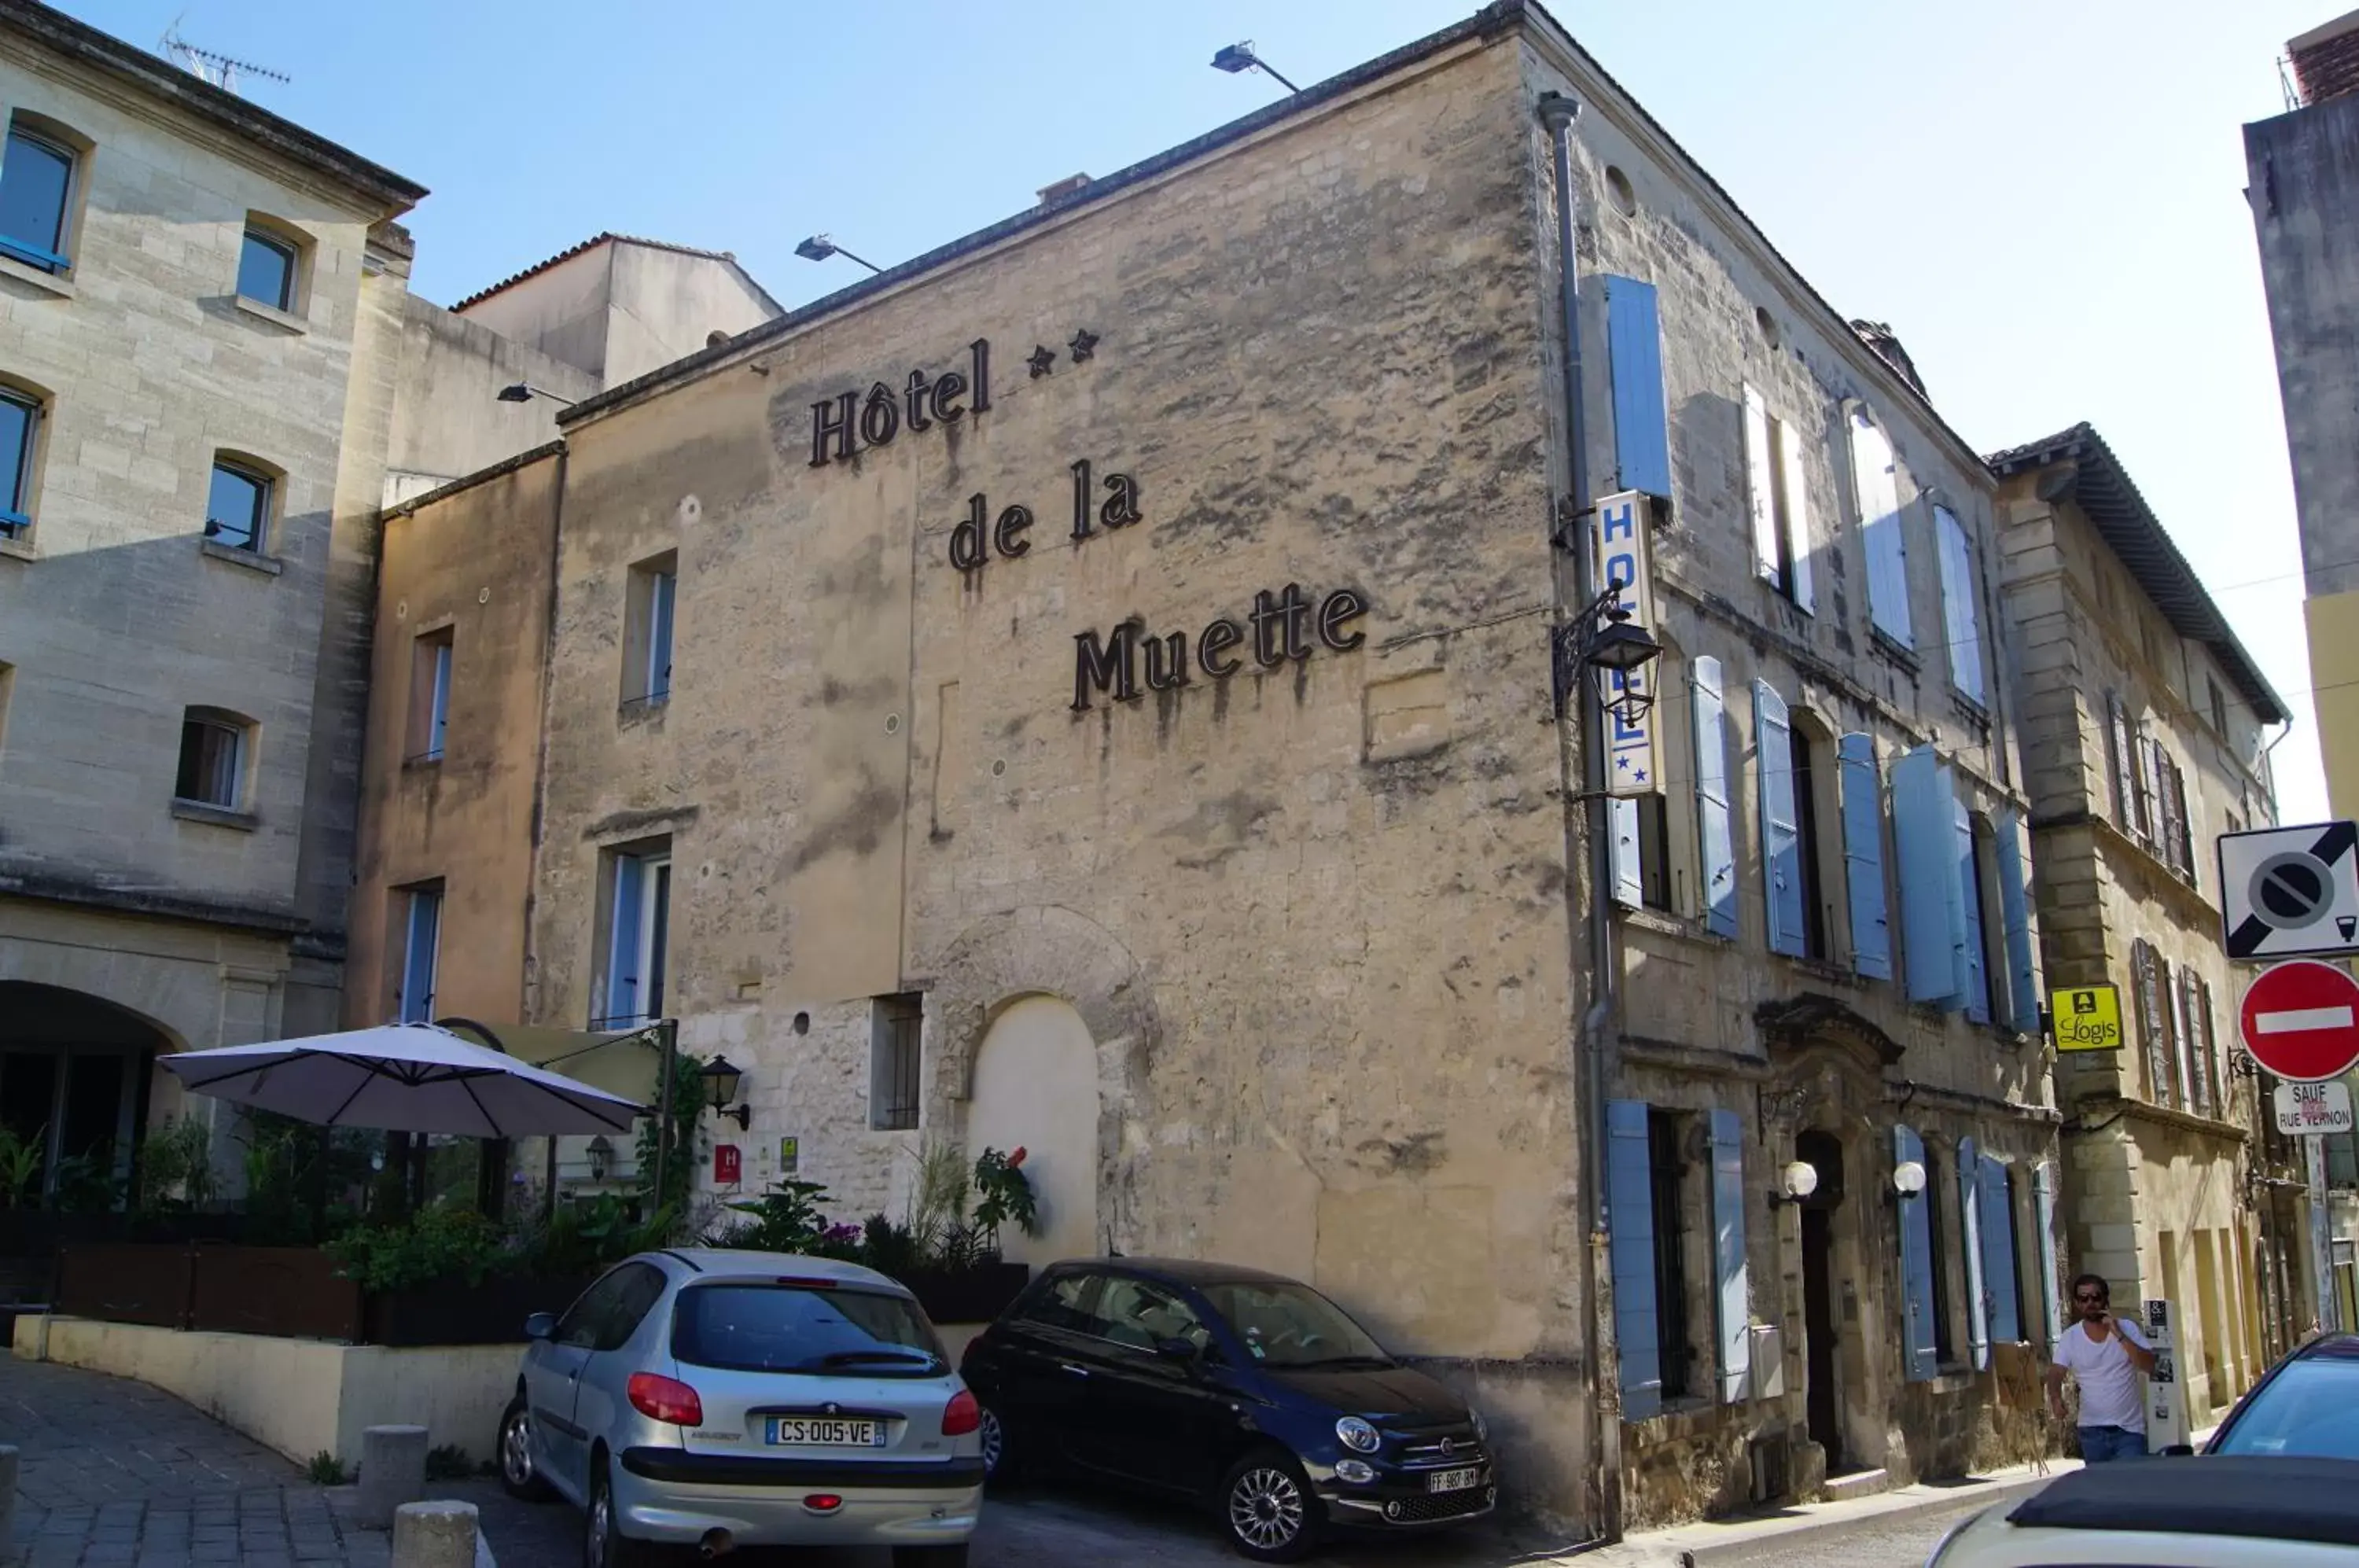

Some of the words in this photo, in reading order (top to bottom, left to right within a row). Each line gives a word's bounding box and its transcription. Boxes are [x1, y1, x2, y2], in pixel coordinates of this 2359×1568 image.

[808, 337, 992, 469] Hôtel
[948, 492, 1035, 574] de
[1069, 458, 1143, 543] la
[1069, 581, 1369, 711] Muette
[1603, 502, 1646, 742] HOEL
[2059, 1014, 2117, 1045] Logis
[2280, 1113, 2302, 1128] RUE
[2305, 1109, 2350, 1126] VERNON
[2292, 1084, 2327, 1103] SAUF
